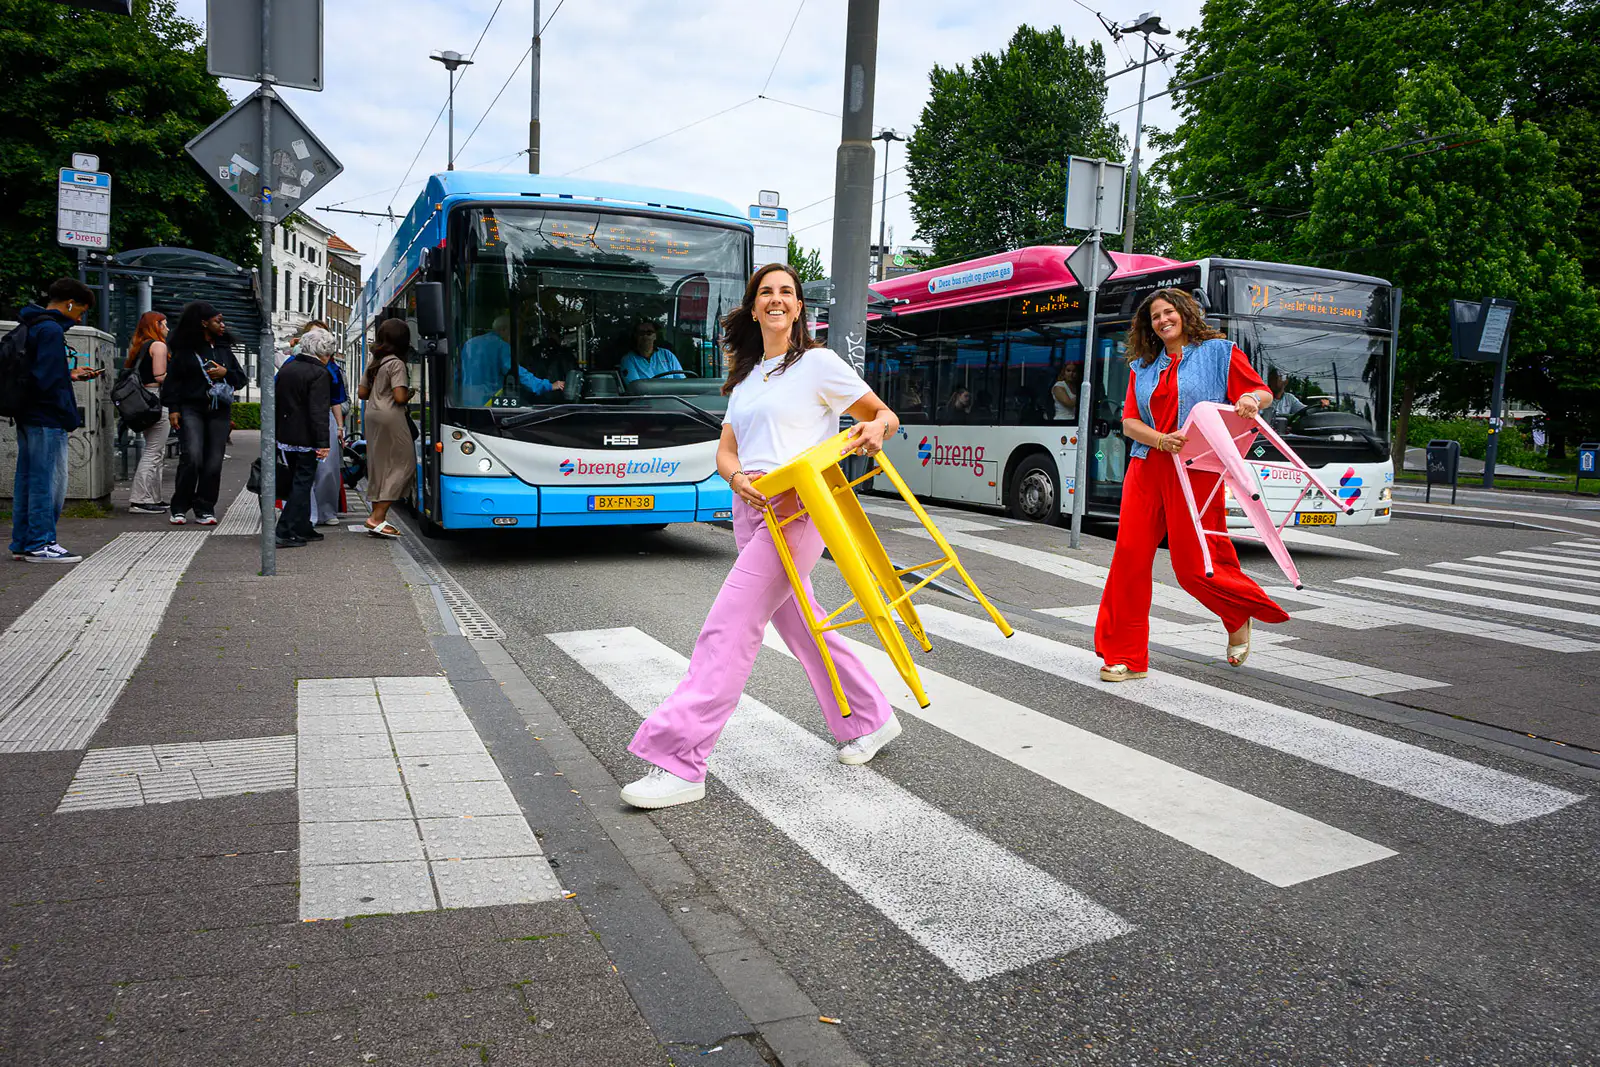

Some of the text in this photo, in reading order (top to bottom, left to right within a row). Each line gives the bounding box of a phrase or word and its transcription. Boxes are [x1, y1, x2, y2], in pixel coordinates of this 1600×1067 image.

[82, 159, 90, 167] A
[767, 195, 773, 203] B
[75, 232, 102, 245] breng
[938, 267, 1011, 289] Deze bus rijdt op groen gas
[1157, 277, 1182, 287] MAN
[1251, 284, 1269, 308] 21
[603, 435, 639, 446] HESS
[934, 436, 985, 477] breng
[577, 458, 681, 478] brengtrolley
[599, 497, 650, 508] BX-FN-38
[1301, 514, 1334, 524] 28-BBG-2
